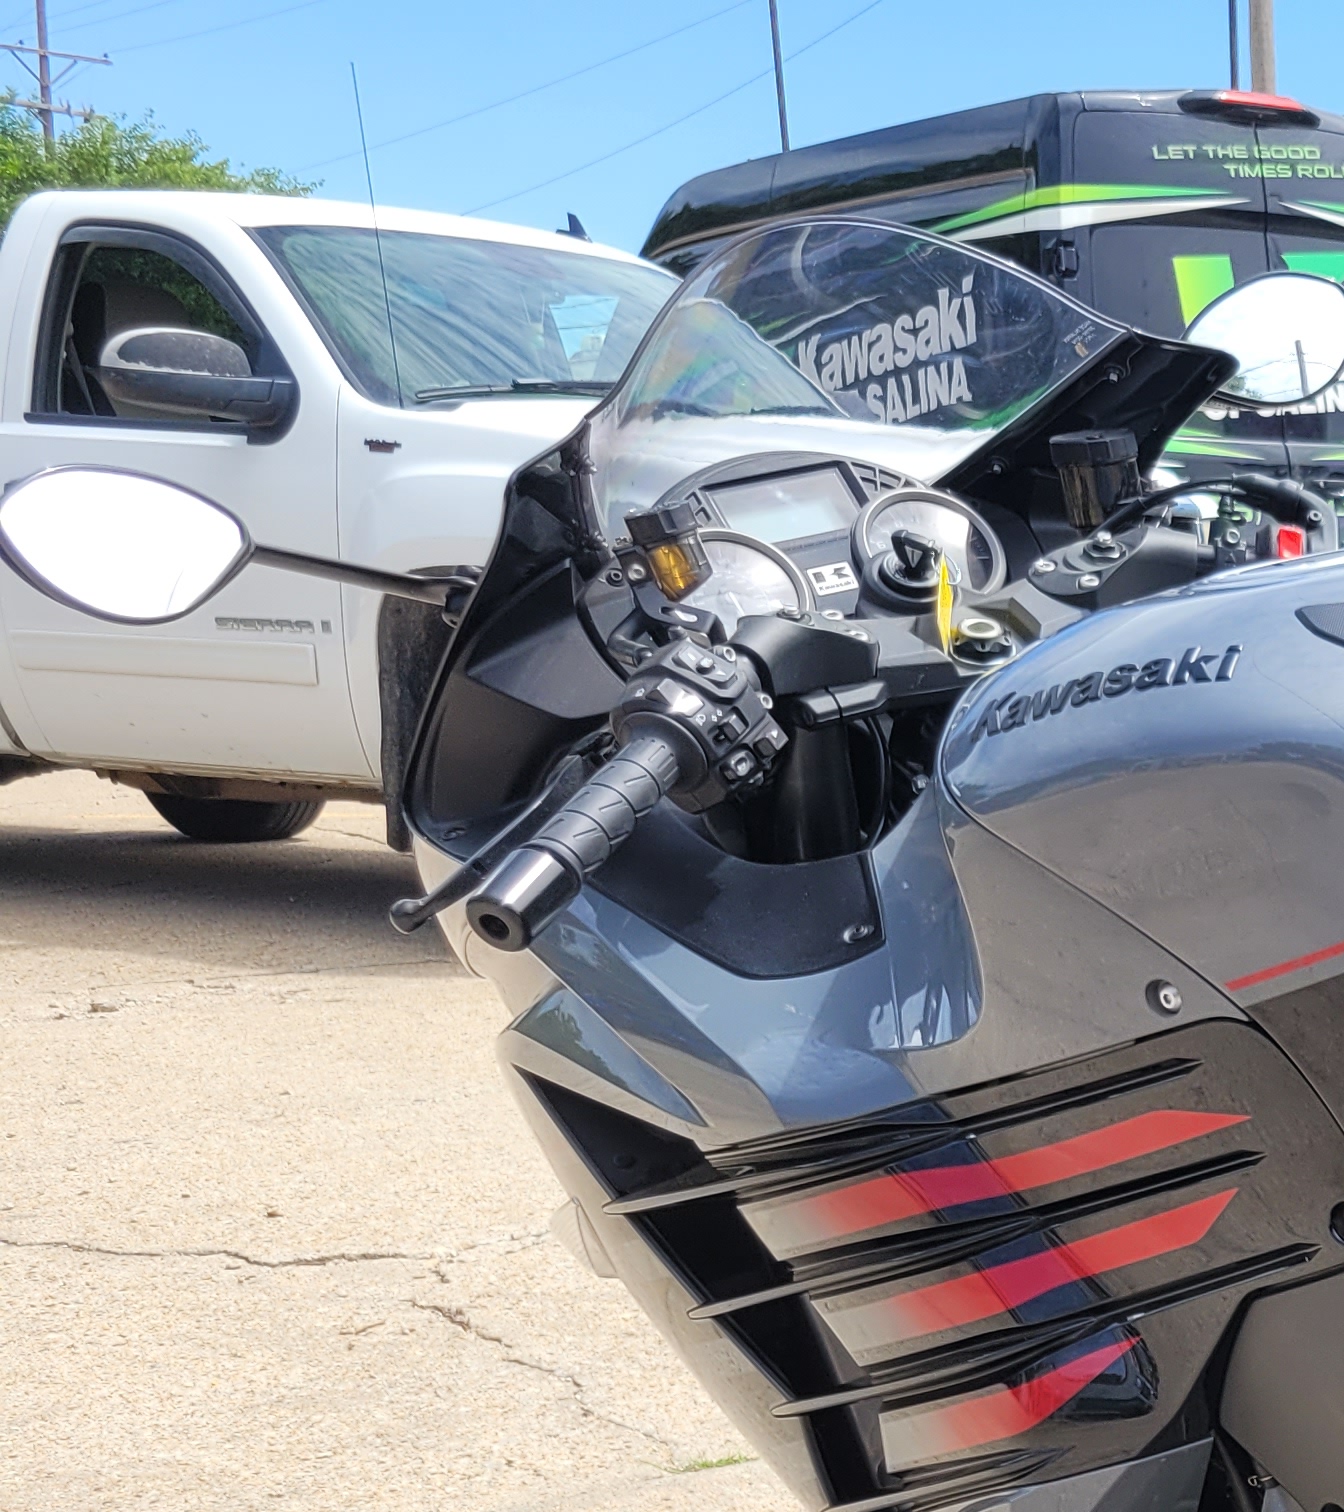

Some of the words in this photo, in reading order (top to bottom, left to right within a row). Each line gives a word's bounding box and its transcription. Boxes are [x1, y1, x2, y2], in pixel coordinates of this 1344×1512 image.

[1151, 144, 1197, 160] LET
[1202, 144, 1249, 160] THE
[1253, 145, 1321, 160] GOOD
[1223, 163, 1293, 179] TIMES
[799, 273, 977, 392] Kawasaki
[866, 357, 973, 425] SALINA
[972, 644, 1244, 742] Kawasaki
